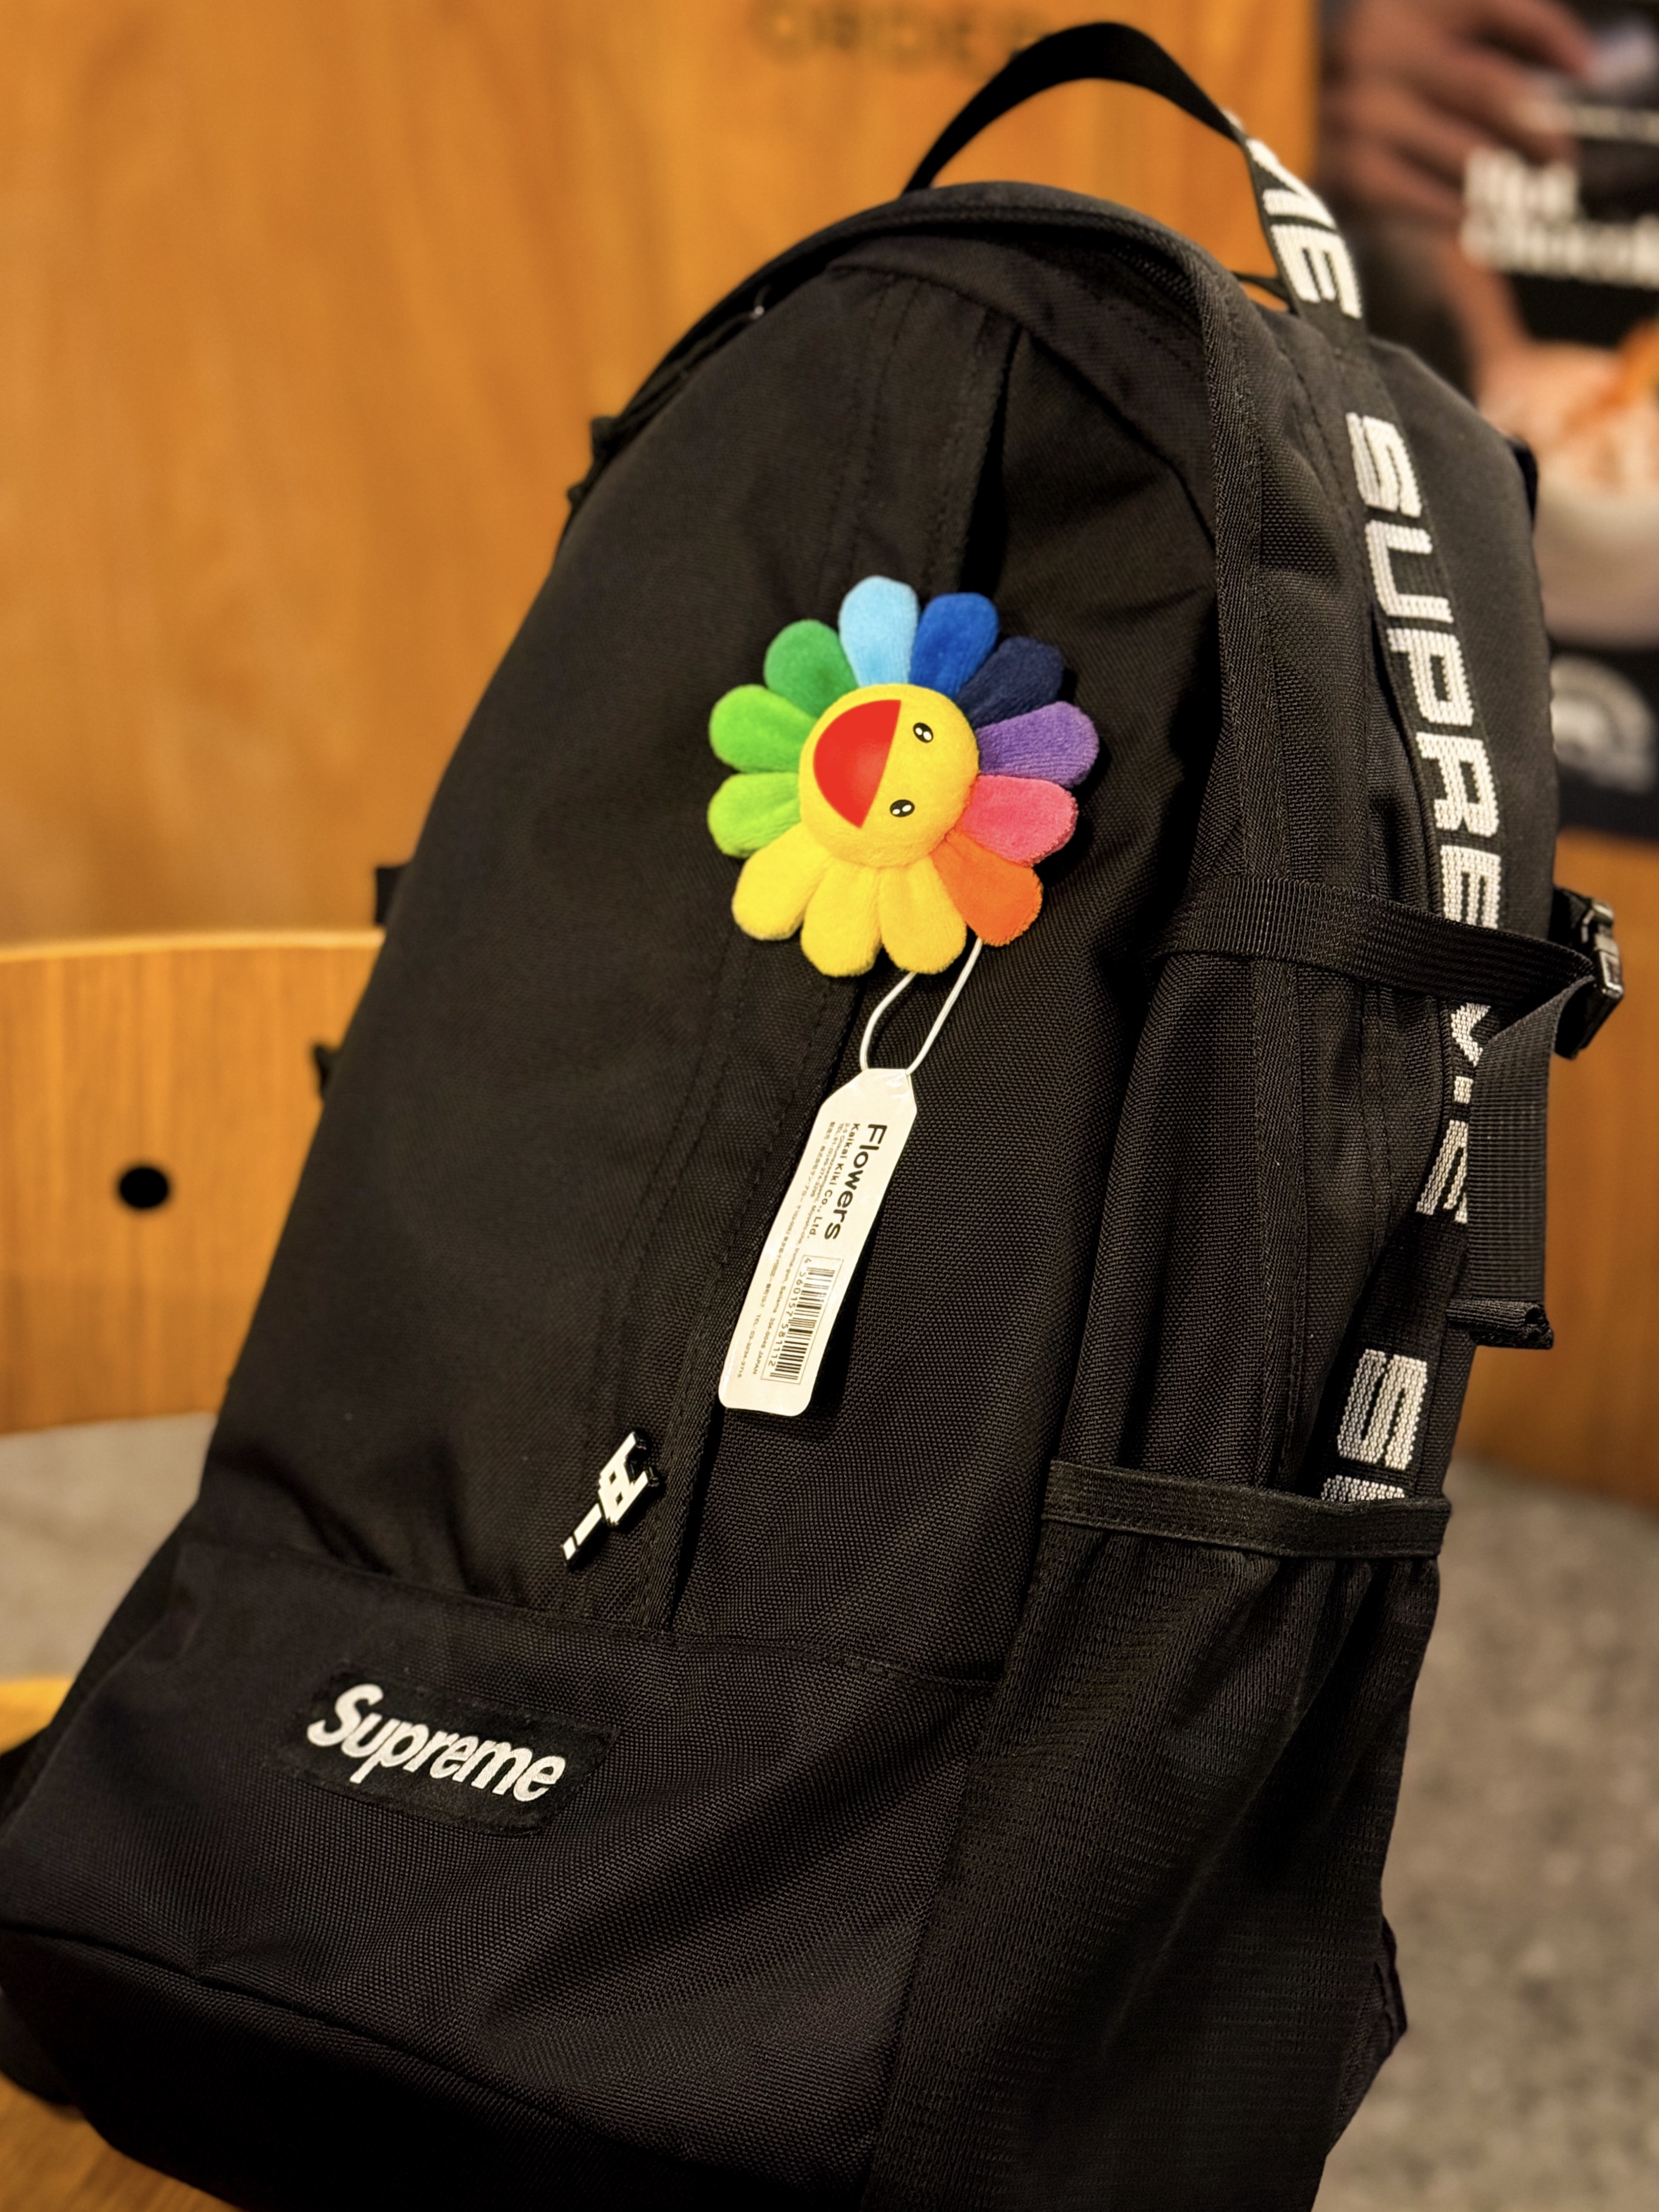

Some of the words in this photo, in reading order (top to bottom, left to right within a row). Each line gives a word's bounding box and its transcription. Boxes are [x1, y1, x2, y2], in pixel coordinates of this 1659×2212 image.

[840, 1123, 860, 1158] Kaikai
[825, 1124, 887, 1239] Flowers
[829, 1163, 844, 1185] Kiki
[817, 1190, 833, 1212] Co.,
[807, 1217, 823, 1238] Ltd.
[786, 1272, 806, 1317] 560157
[753, 1351, 763, 1374] JAPAN
[768, 1324, 789, 1369] 581112
[307, 1684, 566, 1802] Supreme
